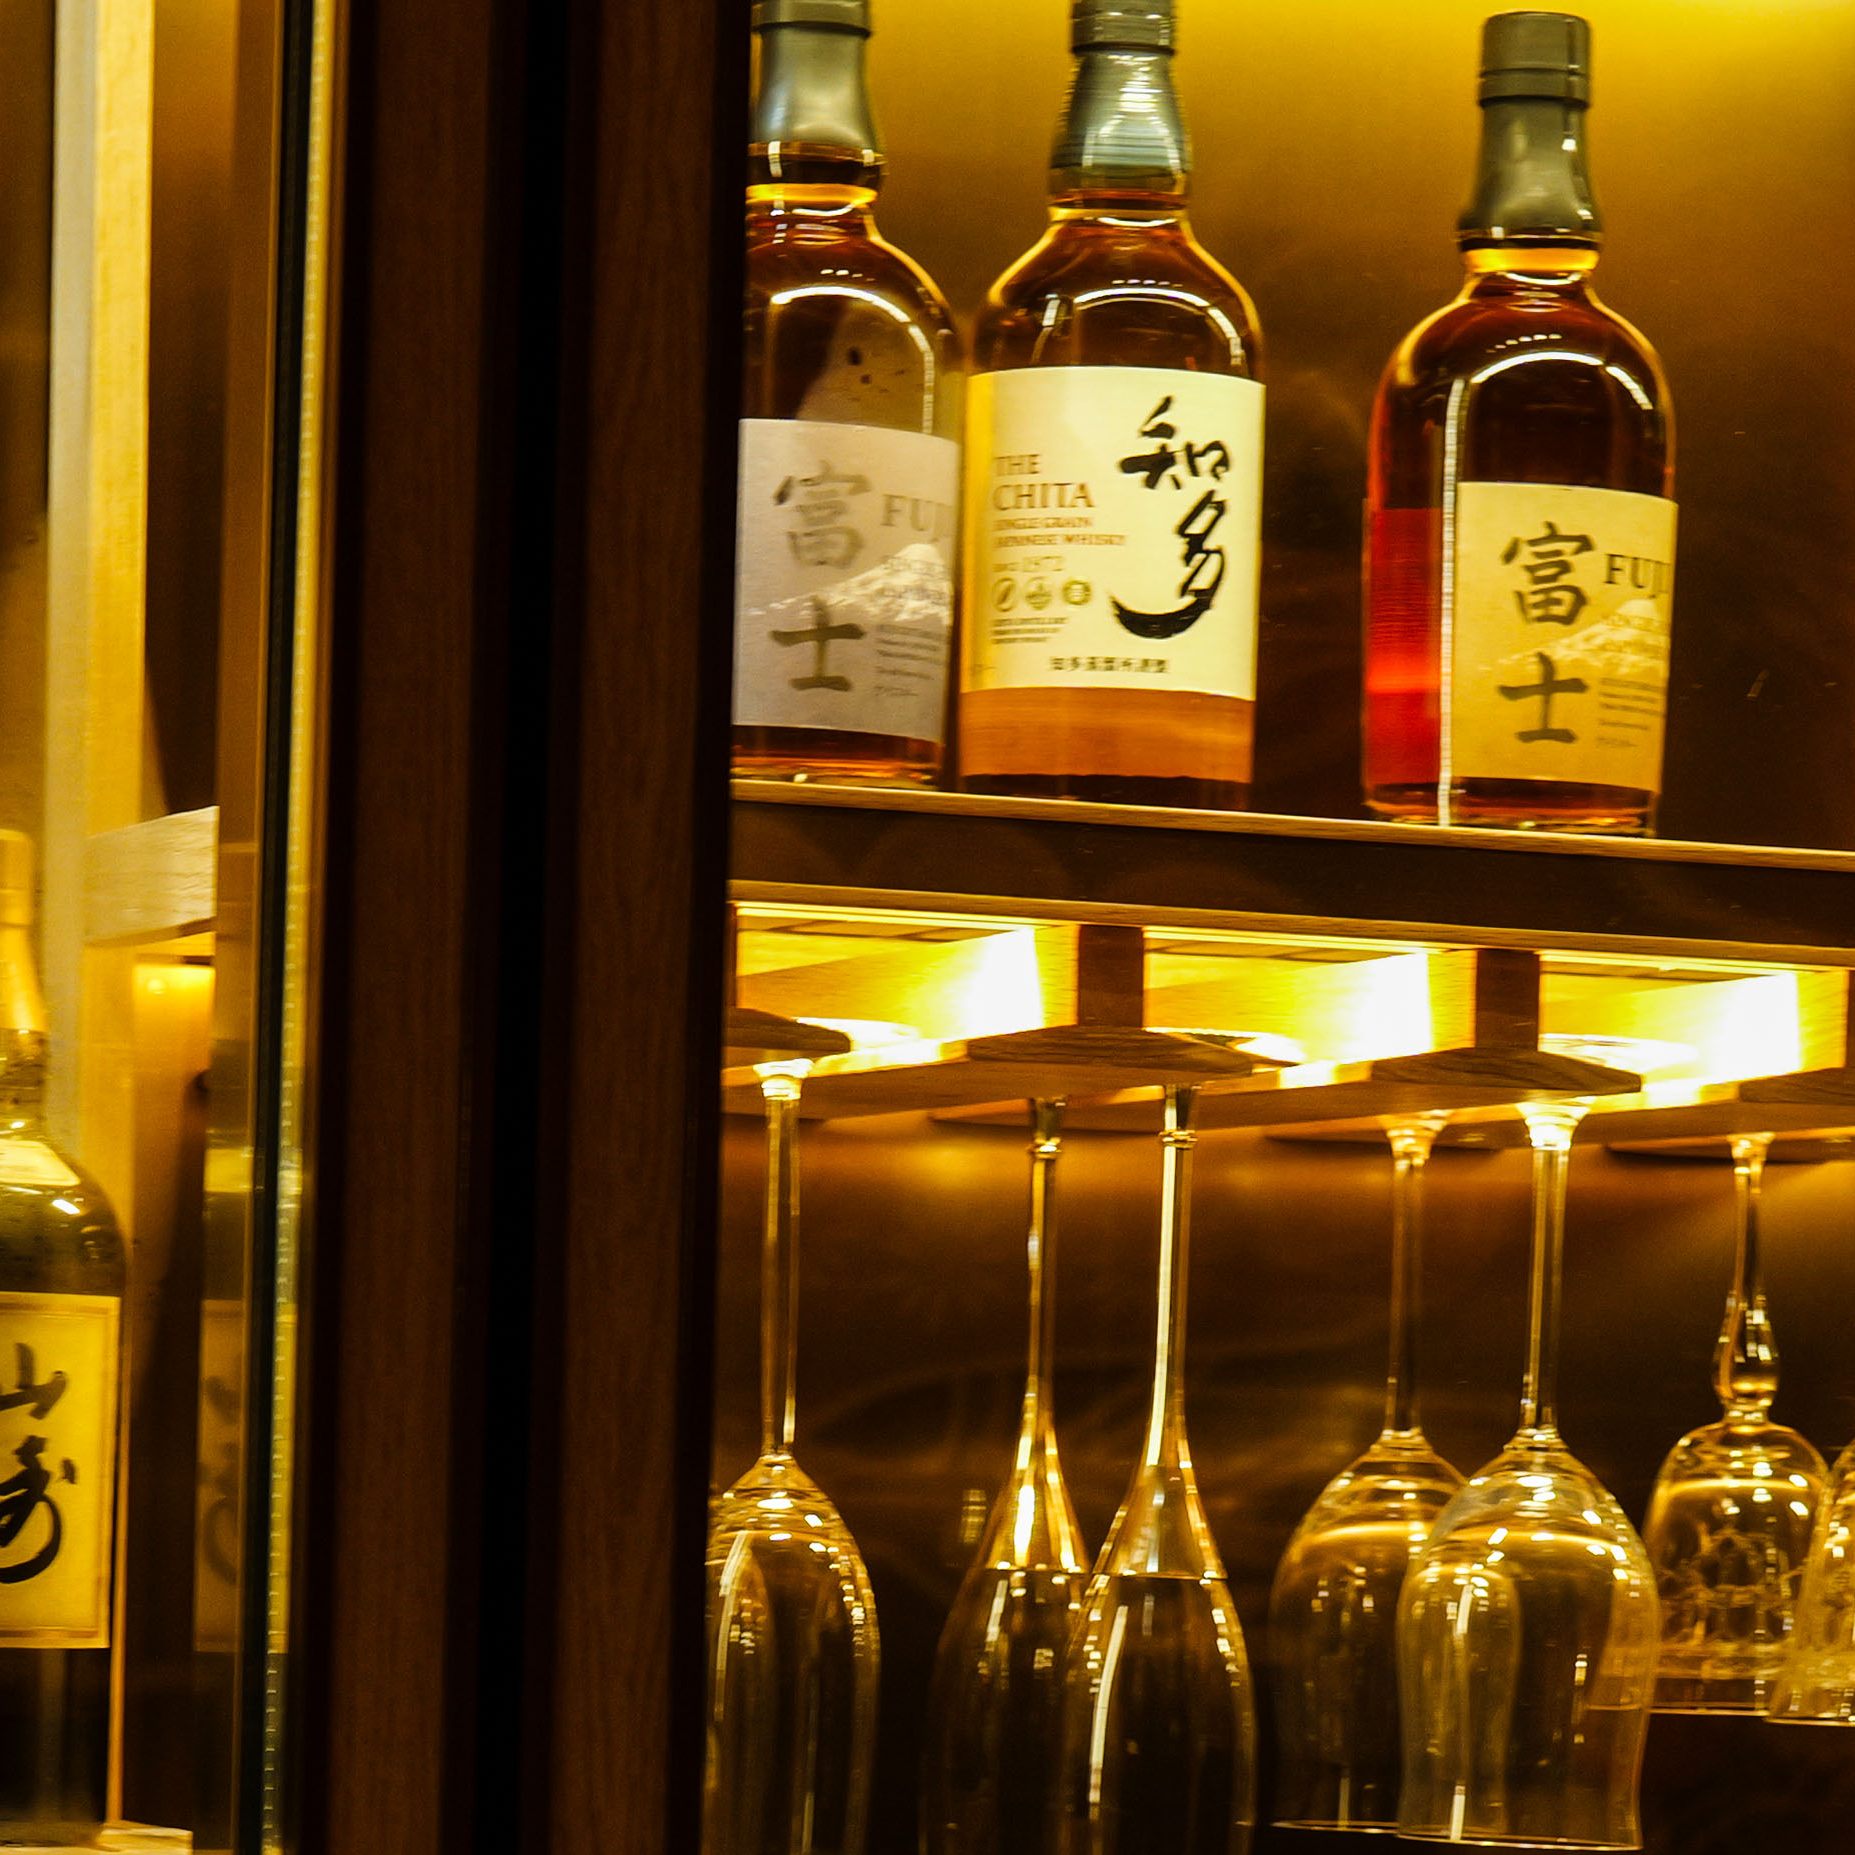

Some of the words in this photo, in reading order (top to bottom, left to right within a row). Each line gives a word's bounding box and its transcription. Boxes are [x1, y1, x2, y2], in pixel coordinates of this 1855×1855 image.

[995, 453, 1041, 476] THE
[995, 482, 1097, 511] CHITA
[768, 460, 872, 692] 富士
[1498, 520, 1596, 744] 富士
